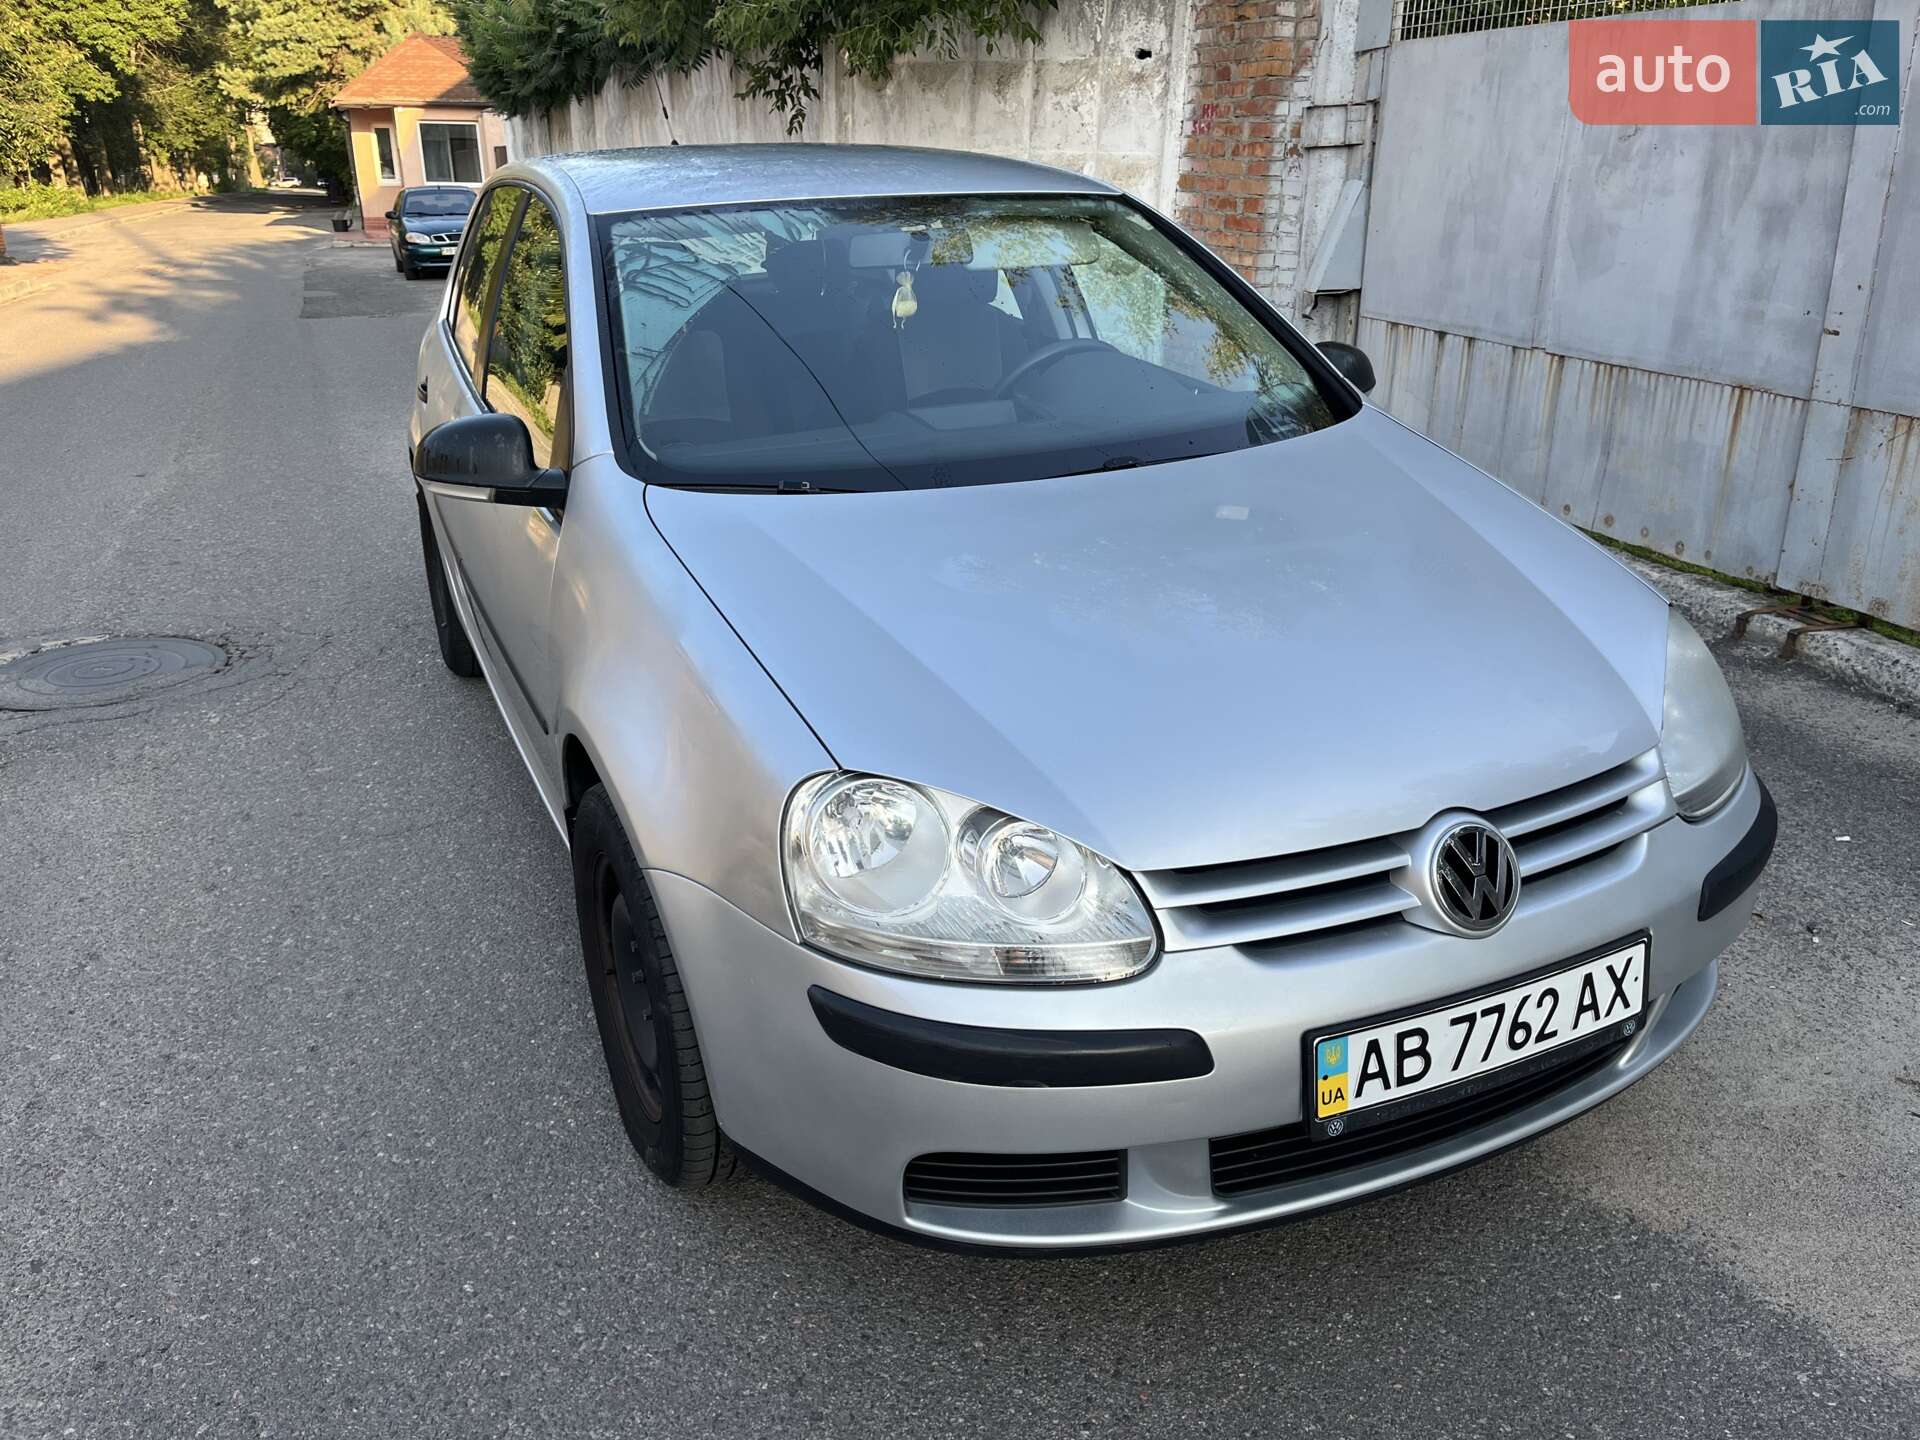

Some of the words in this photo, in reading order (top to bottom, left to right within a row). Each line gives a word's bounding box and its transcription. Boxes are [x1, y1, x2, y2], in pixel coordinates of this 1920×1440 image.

[1354, 1027, 1432, 1099] AB
[1448, 987, 1560, 1072] 7762
[1571, 956, 1634, 1030] AX
[1321, 1087, 1345, 1106] UA
